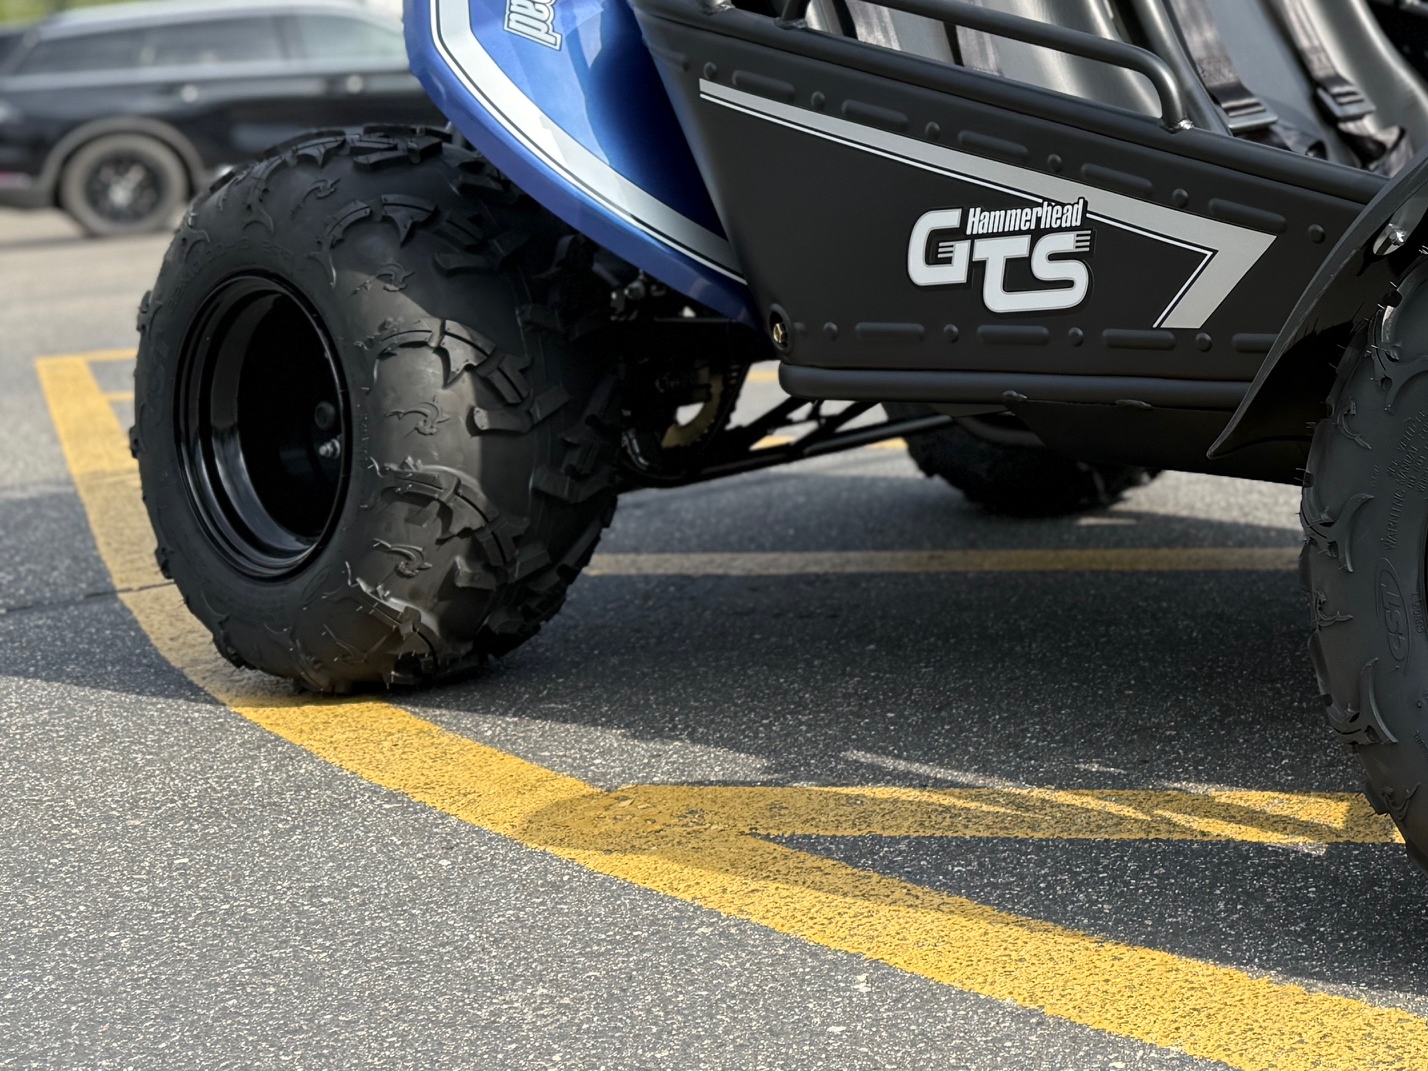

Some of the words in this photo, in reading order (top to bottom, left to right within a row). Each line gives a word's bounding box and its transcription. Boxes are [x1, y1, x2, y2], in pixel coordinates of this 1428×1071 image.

[966, 198, 1084, 235] Hammerhead
[907, 208, 1092, 313] GTS
[1395, 443, 1418, 485] MANUAL
[1383, 484, 1406, 552] WARNING
